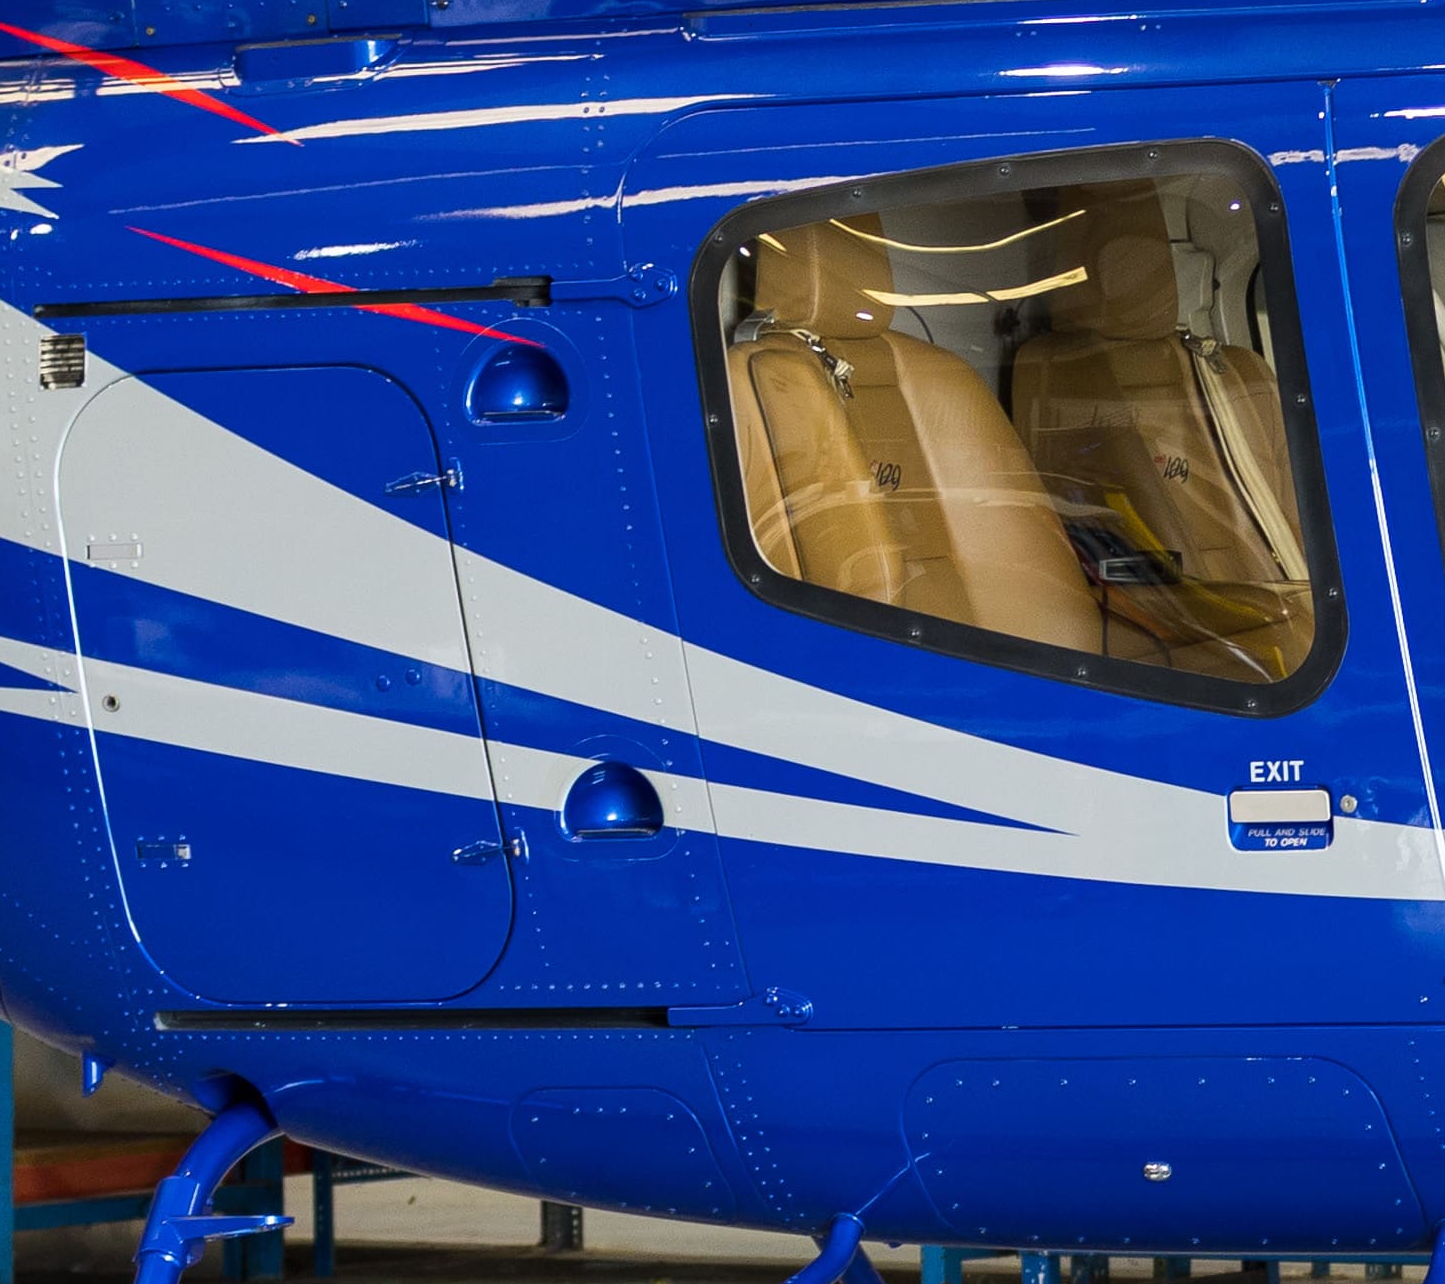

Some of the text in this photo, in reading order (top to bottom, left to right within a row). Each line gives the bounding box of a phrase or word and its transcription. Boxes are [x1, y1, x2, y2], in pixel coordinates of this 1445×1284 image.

[1249, 760, 1305, 783] EXIT
[1247, 827, 1326, 837] PULL AND SLIDE
[1264, 837, 1308, 847] TO OPEN
